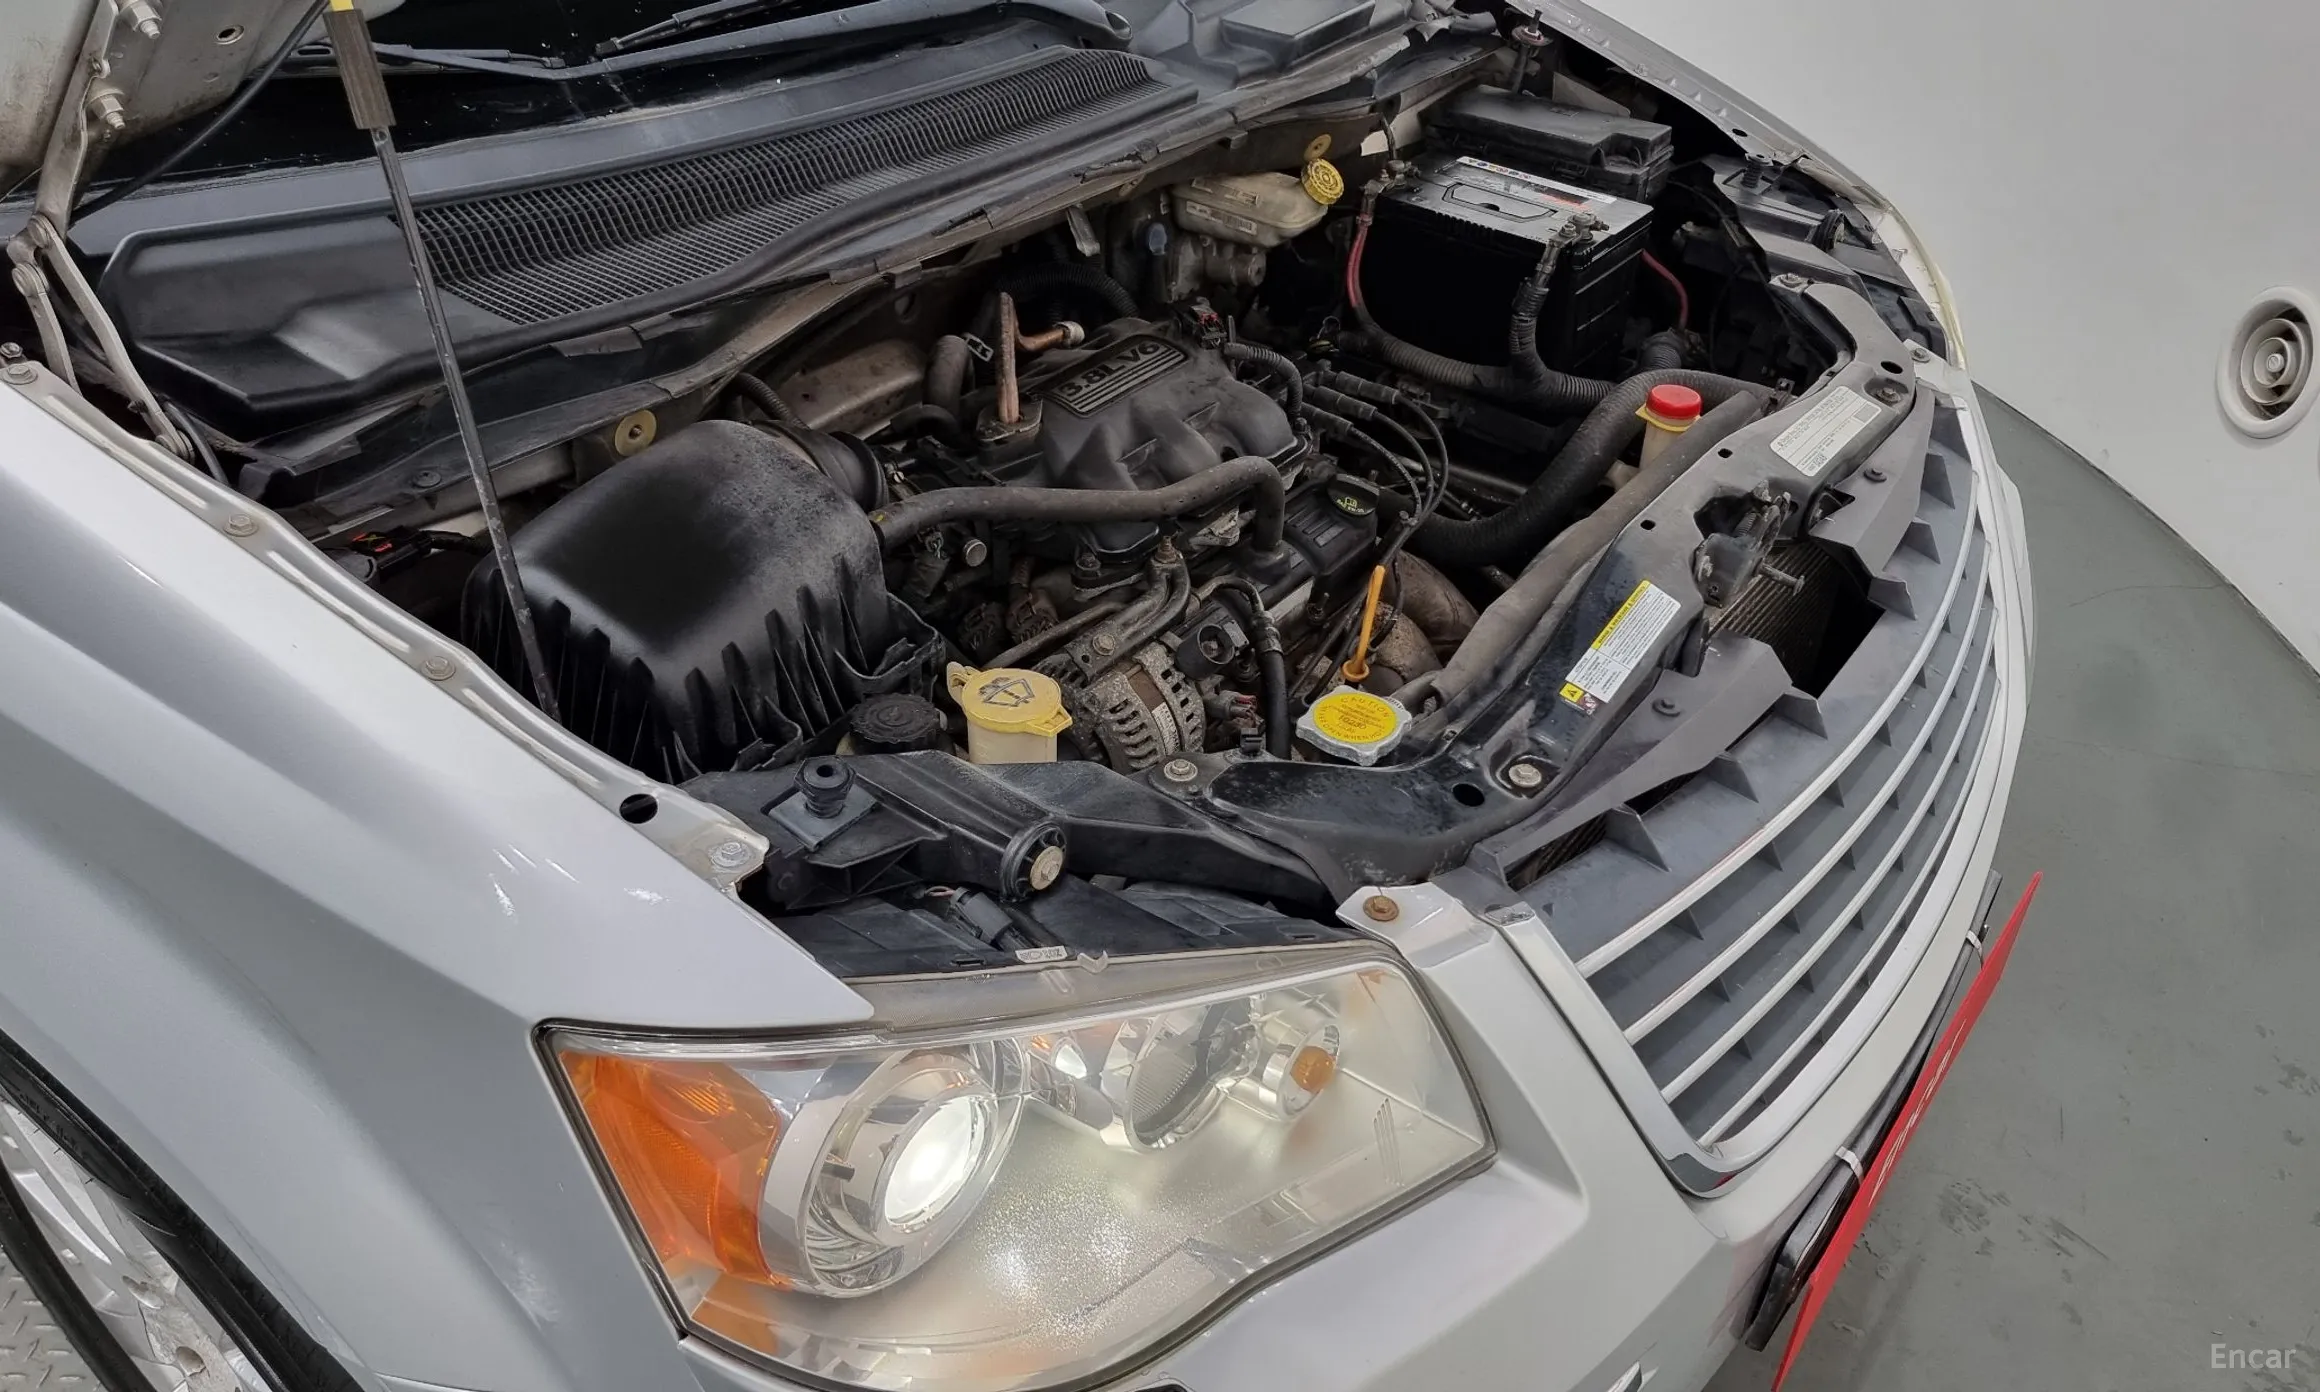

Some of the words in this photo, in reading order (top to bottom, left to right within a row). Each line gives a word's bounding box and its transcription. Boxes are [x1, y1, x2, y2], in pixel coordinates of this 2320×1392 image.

[1058, 364, 1126, 397] 3.8L
[1116, 341, 1161, 363] V6
[1340, 696, 1390, 718] CAUTION
